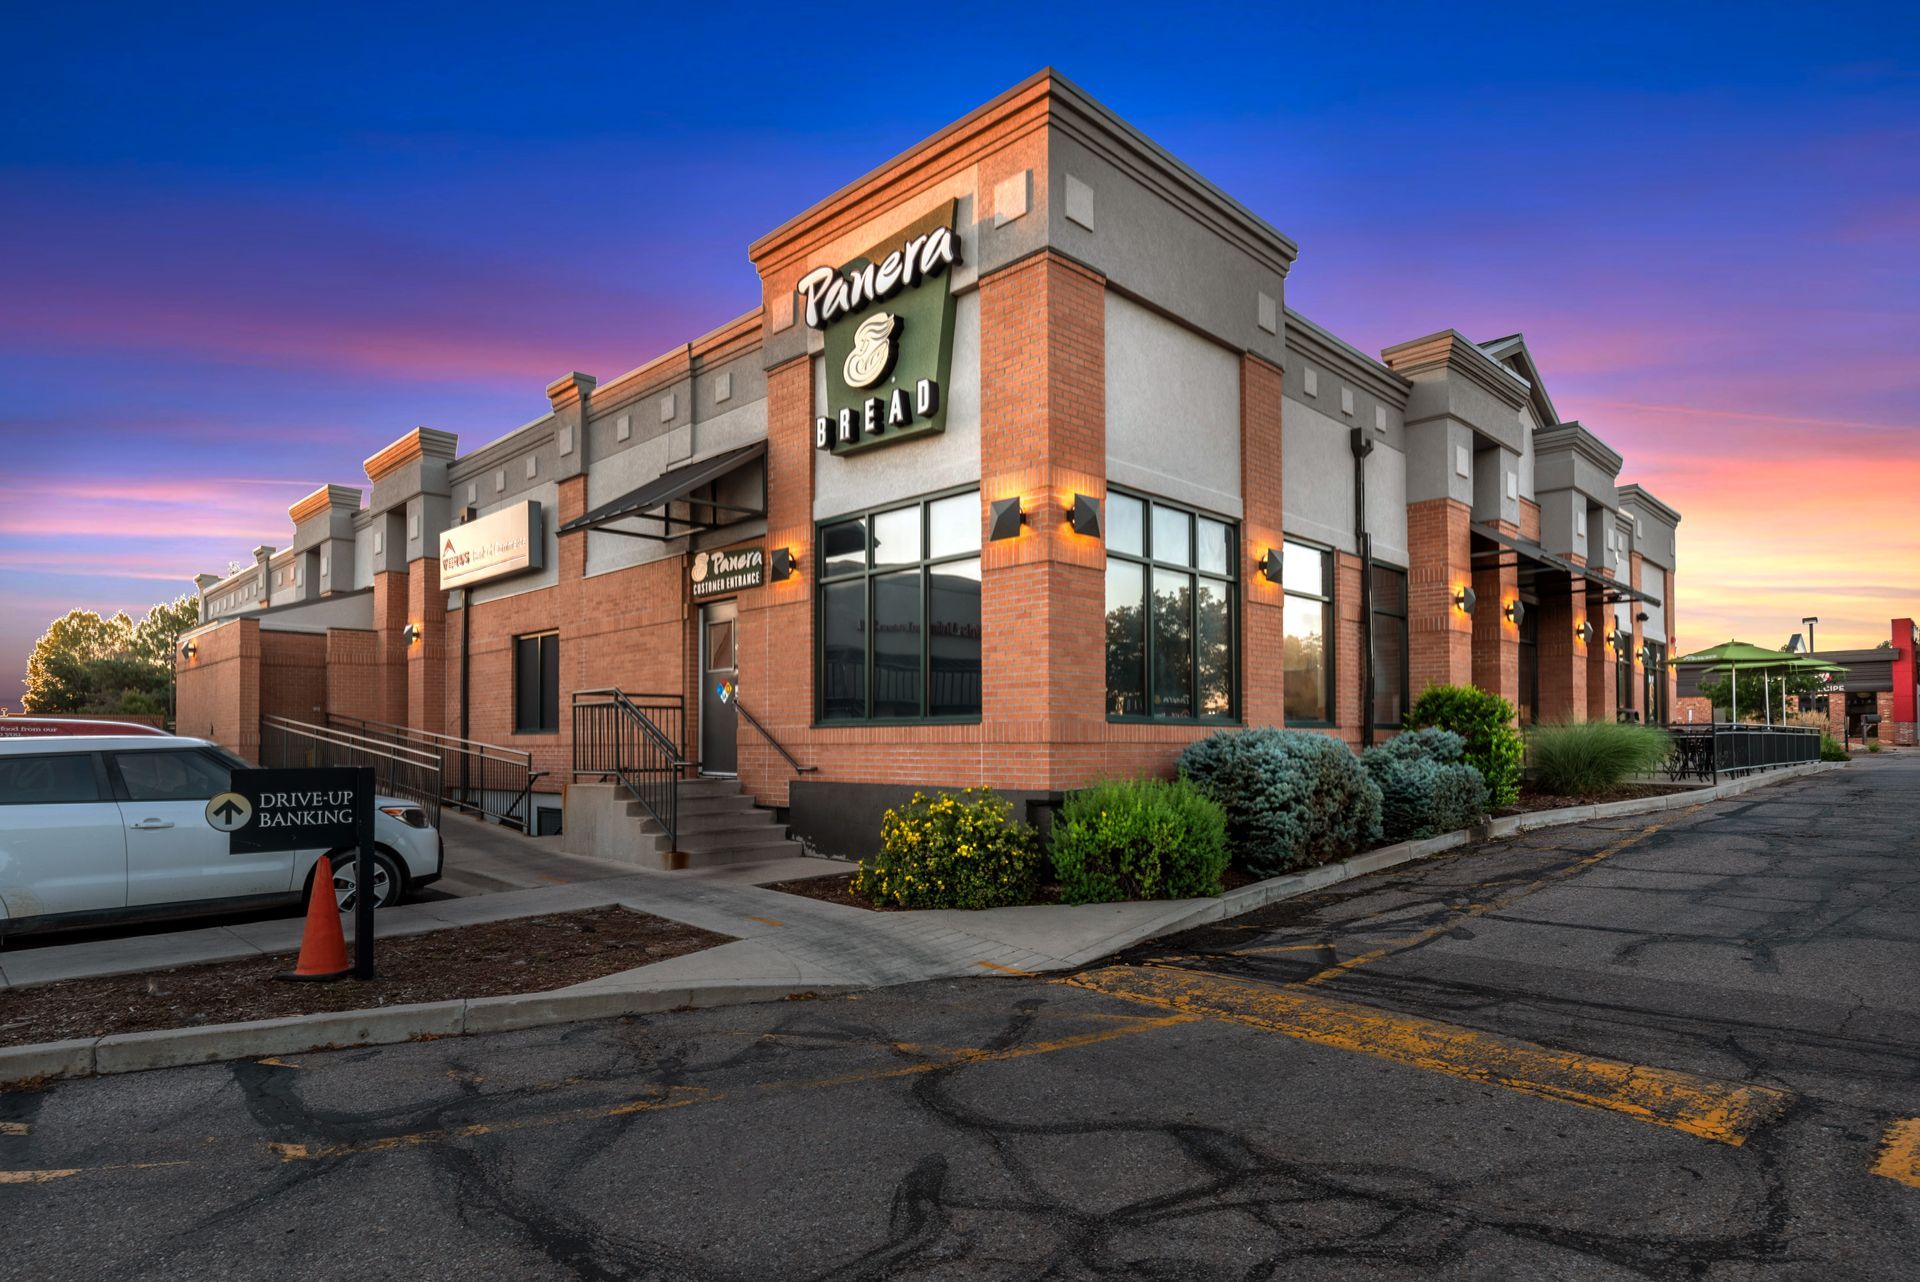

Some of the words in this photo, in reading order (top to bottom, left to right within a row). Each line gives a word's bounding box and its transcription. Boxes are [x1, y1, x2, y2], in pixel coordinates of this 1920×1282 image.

[798, 226, 956, 328] Panera
[816, 378, 935, 449] BREAD
[711, 551, 763, 575] Panera
[693, 578, 725, 596] CUSTOMER
[726, 571, 760, 589] ENTRANCE
[259, 791, 354, 808] DRIVE-UP
[259, 809, 353, 828] BANKING
